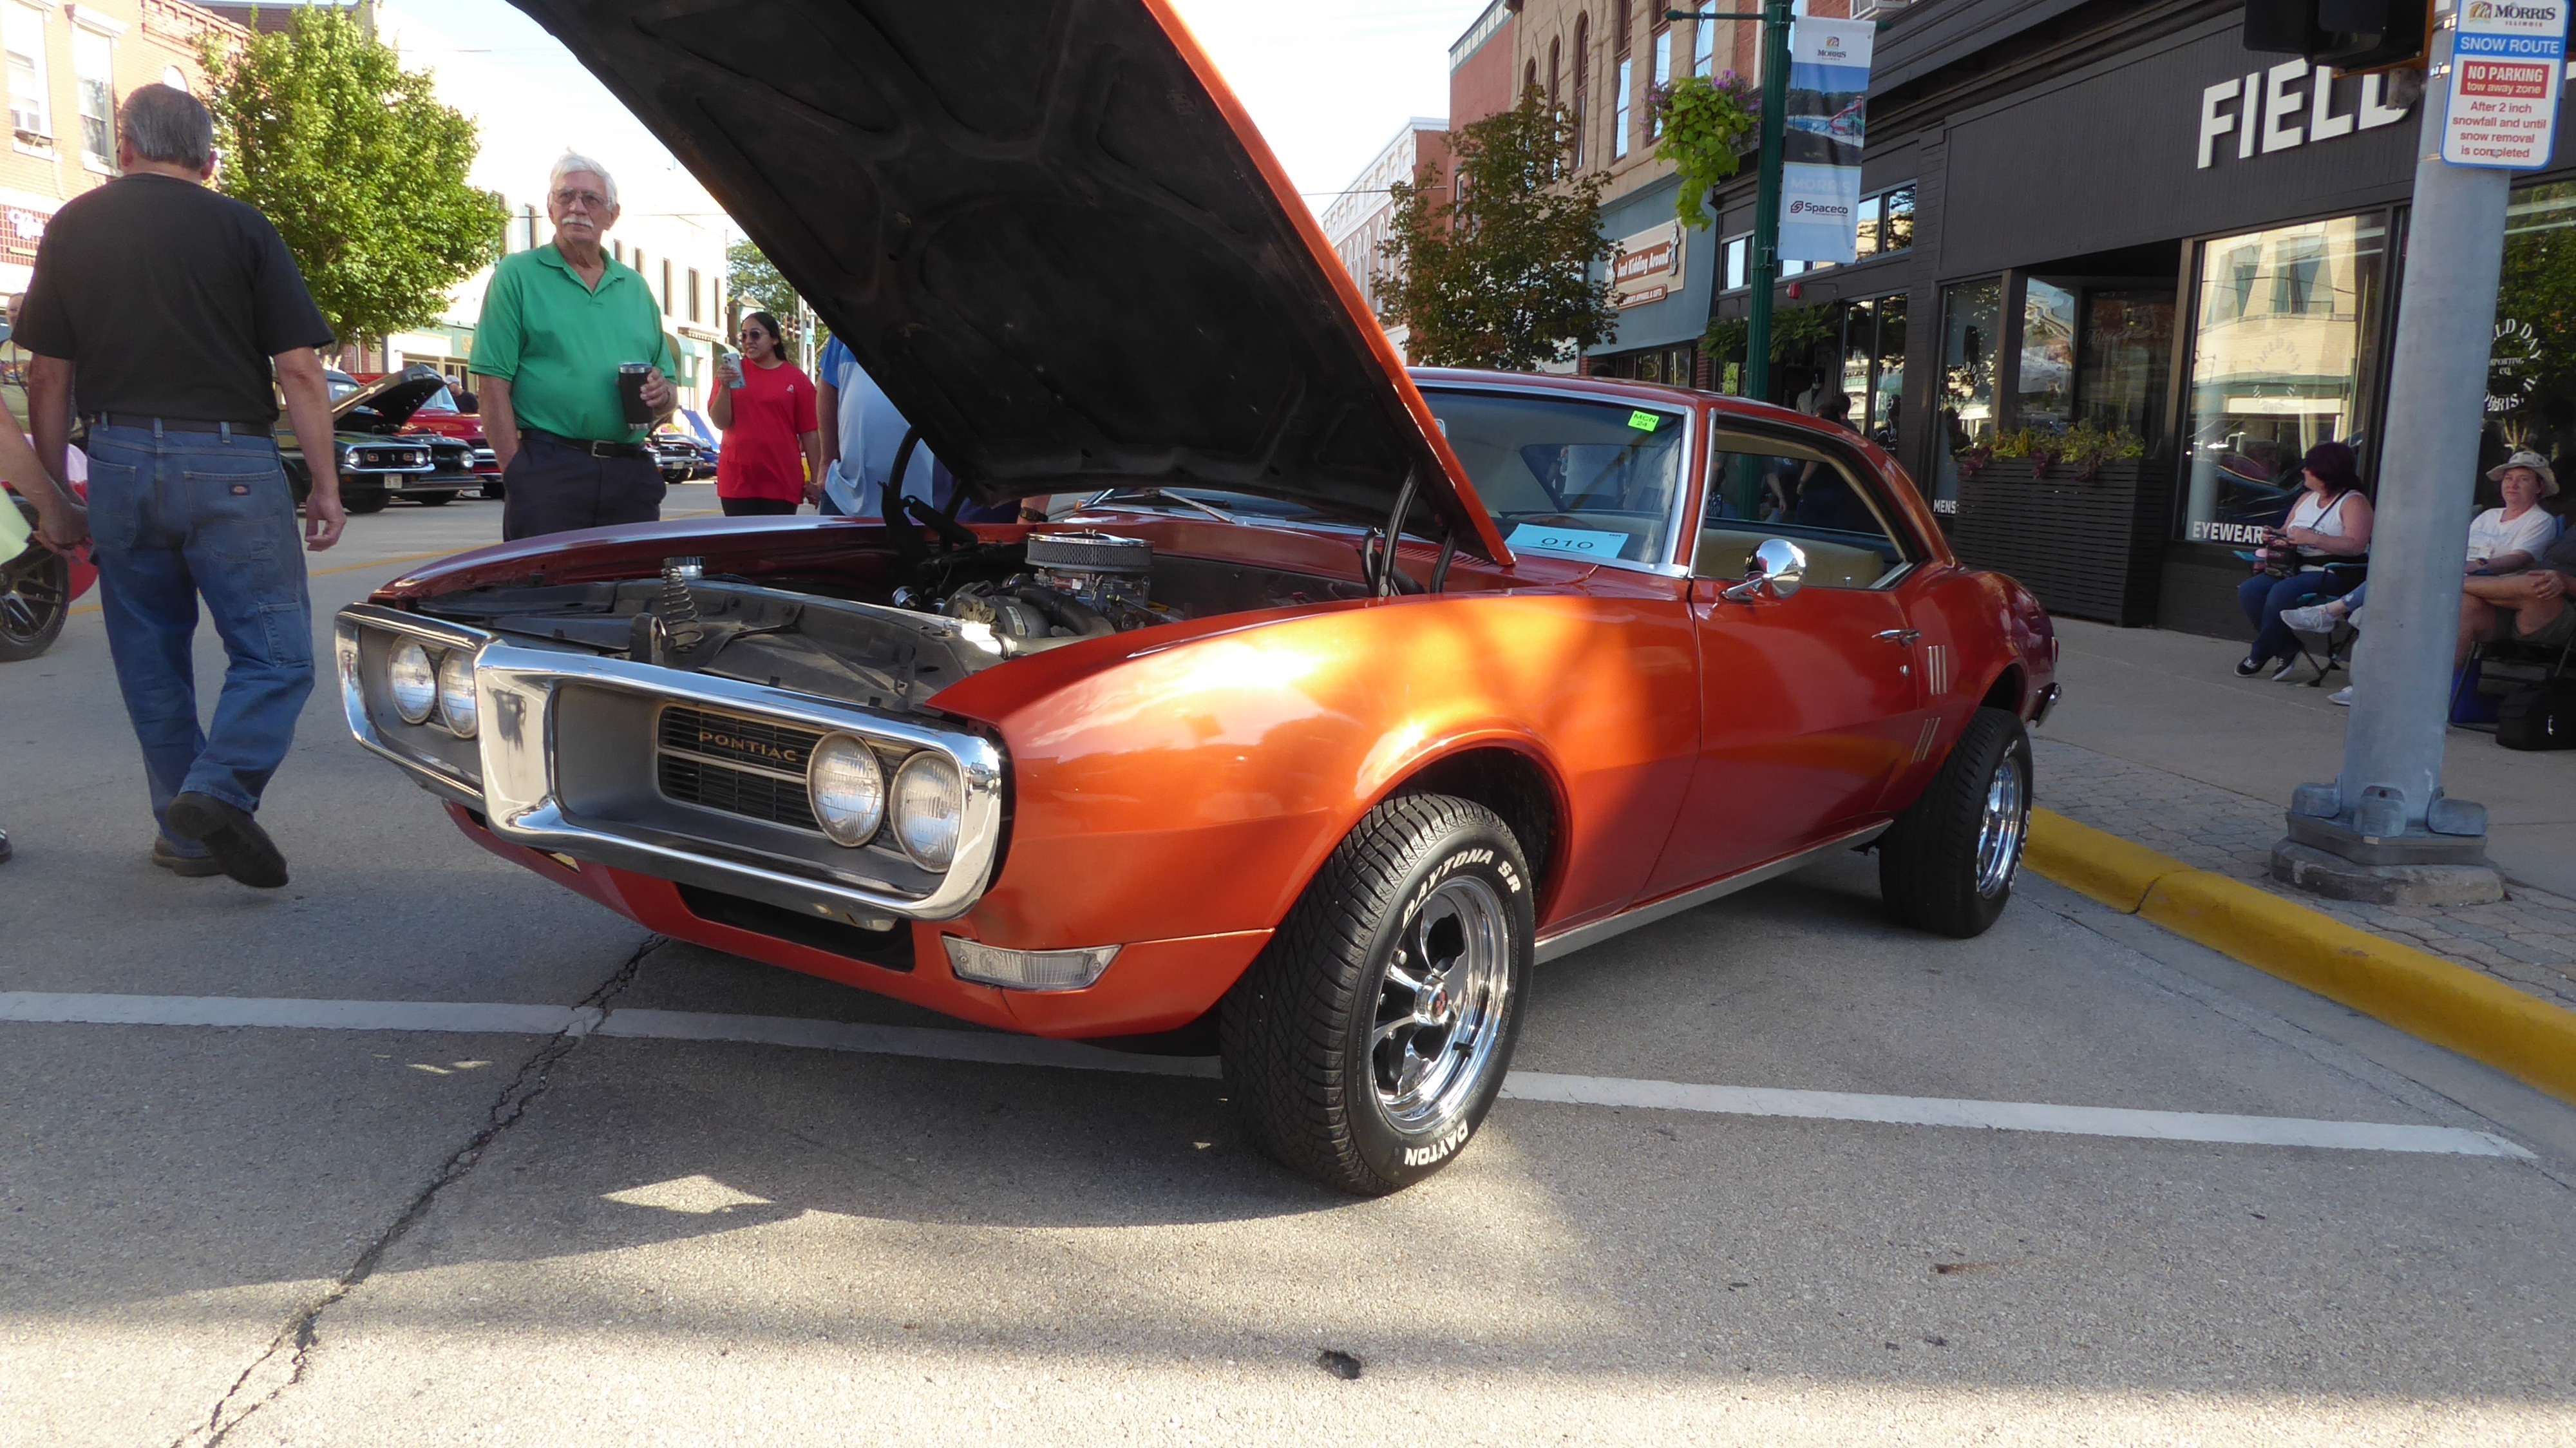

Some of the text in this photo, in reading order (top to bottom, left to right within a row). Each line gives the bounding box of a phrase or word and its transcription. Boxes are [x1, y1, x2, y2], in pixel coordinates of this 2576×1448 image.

[2494, 5, 2556, 21] MORRIS
[2460, 37, 2560, 54] SNOW ROUTE
[2468, 66, 2543, 82] NO PARKING
[2467, 82, 2541, 95] tow away zone
[2470, 101, 2532, 113] After 2 inch
[2452, 115, 2546, 129] snowfall and until
[2460, 132, 2535, 143] snow removal
[2461, 145, 2470, 156] is
[1804, 202, 1848, 214] Spaceco
[1617, 262, 1628, 278] Just
[1628, 254, 1649, 276] Kidding
[1634, 414, 1656, 423] MCN
[1933, 499, 1956, 515] MENS
[2193, 521, 2264, 544] EYEWEAR
[1541, 537, 1595, 549] 010
[699, 732, 797, 761] PONTIAC
[1403, 848, 1521, 929] DAYTONA SR
[1404, 1119, 1469, 1166] DAYTON
